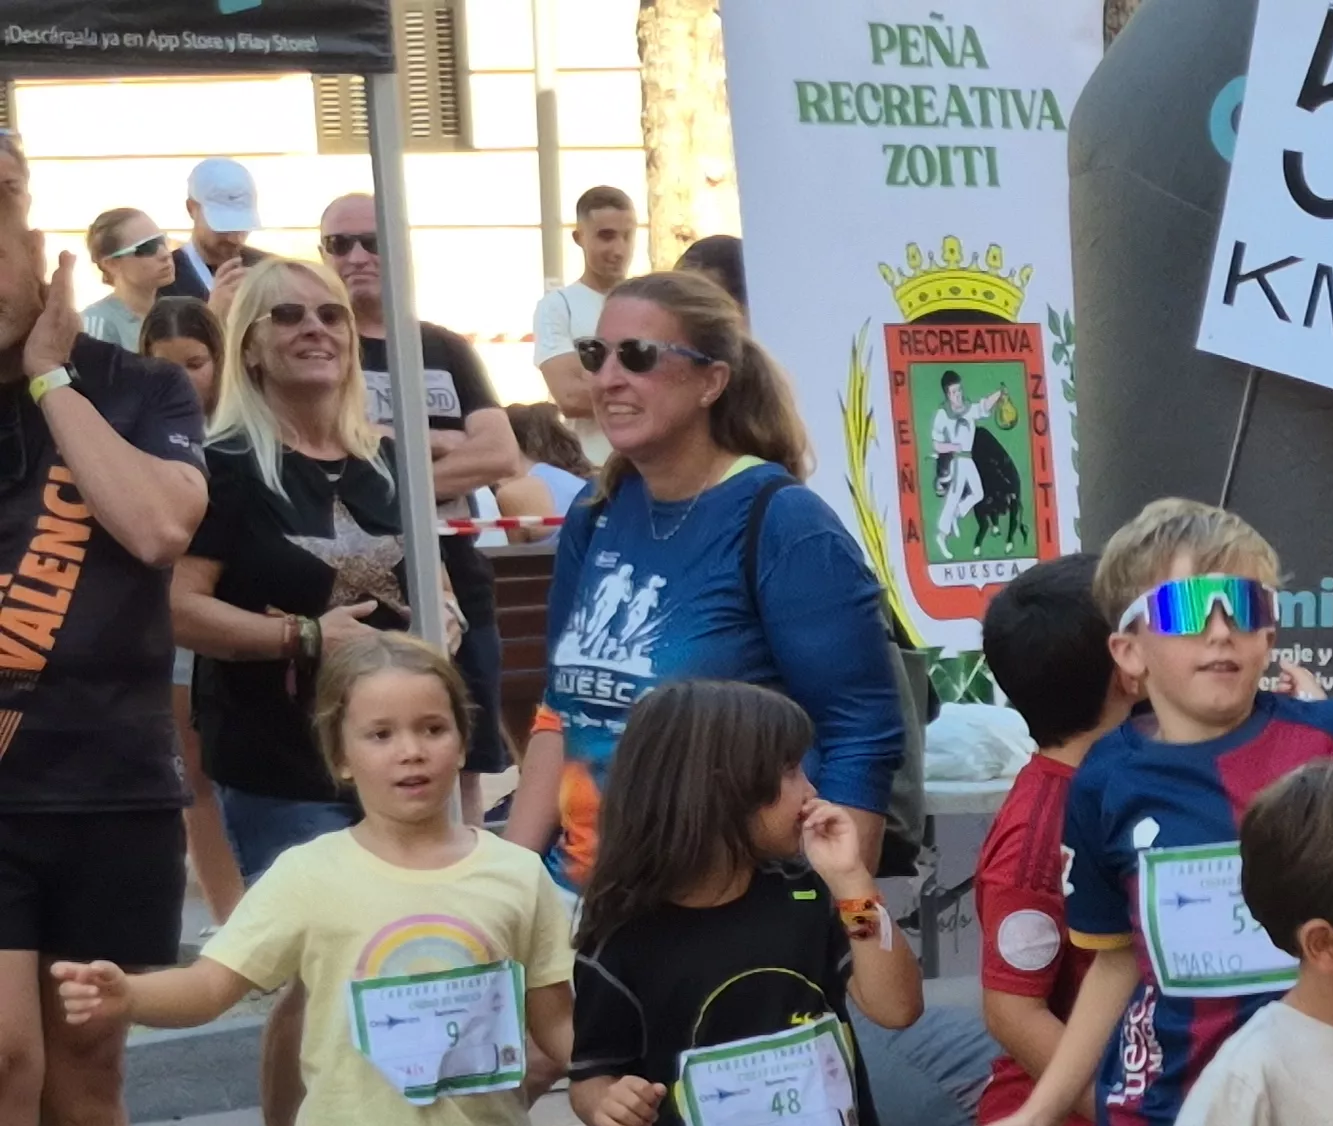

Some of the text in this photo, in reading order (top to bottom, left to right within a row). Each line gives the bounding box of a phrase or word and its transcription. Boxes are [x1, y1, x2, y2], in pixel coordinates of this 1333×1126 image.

[101, 33, 120, 48] ya
[124, 33, 143, 46] en
[147, 30, 179, 50] App
[183, 32, 223, 49] Store
[225, 38, 235, 52] y
[237, 33, 270, 53] Play
[273, 35, 319, 51] Store!
[867, 11, 989, 69] PEÑA
[793, 80, 1067, 131] RECREATIVA
[882, 144, 1001, 187] ZOITI
[898, 329, 1033, 356] RECREATIVA
[892, 370, 920, 544] PEÑA
[1030, 374, 1053, 543] ZOITI
[944, 562, 1021, 582] HUESCA
[1317, 648, 1333, 667] y
[447, 1021, 460, 1048] 9
[770, 1087, 801, 1117] 48
